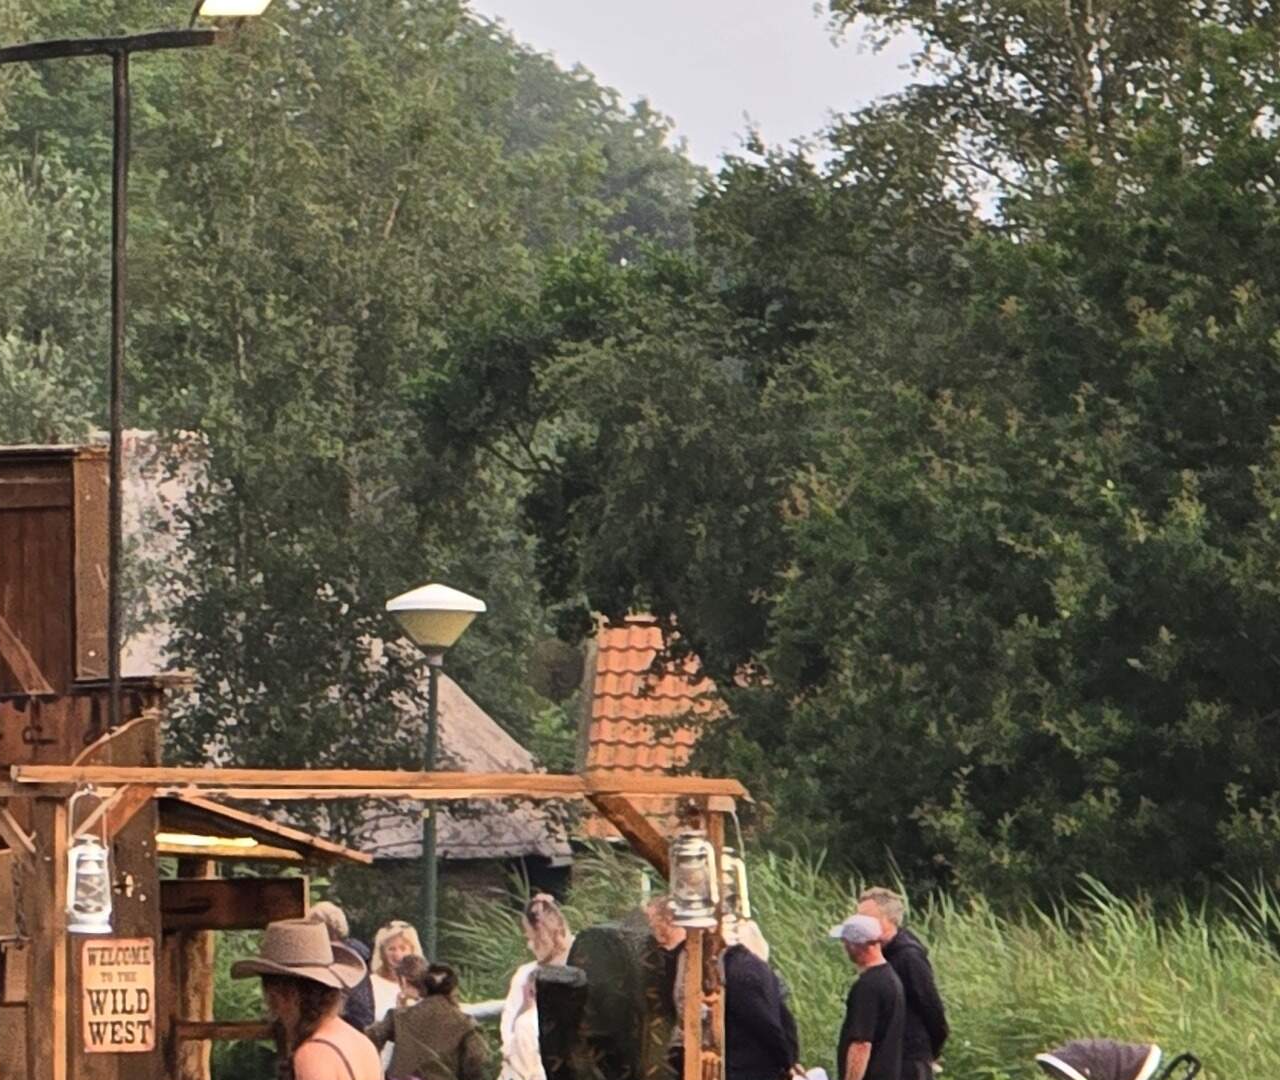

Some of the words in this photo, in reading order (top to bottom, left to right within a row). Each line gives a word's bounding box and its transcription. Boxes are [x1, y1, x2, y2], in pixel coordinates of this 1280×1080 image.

[87, 945, 151, 967] WELCOME
[100, 971, 113, 982] TO
[117, 971, 137, 982] THE
[86, 988, 150, 1016] WILD
[88, 1020, 153, 1046] WEST
